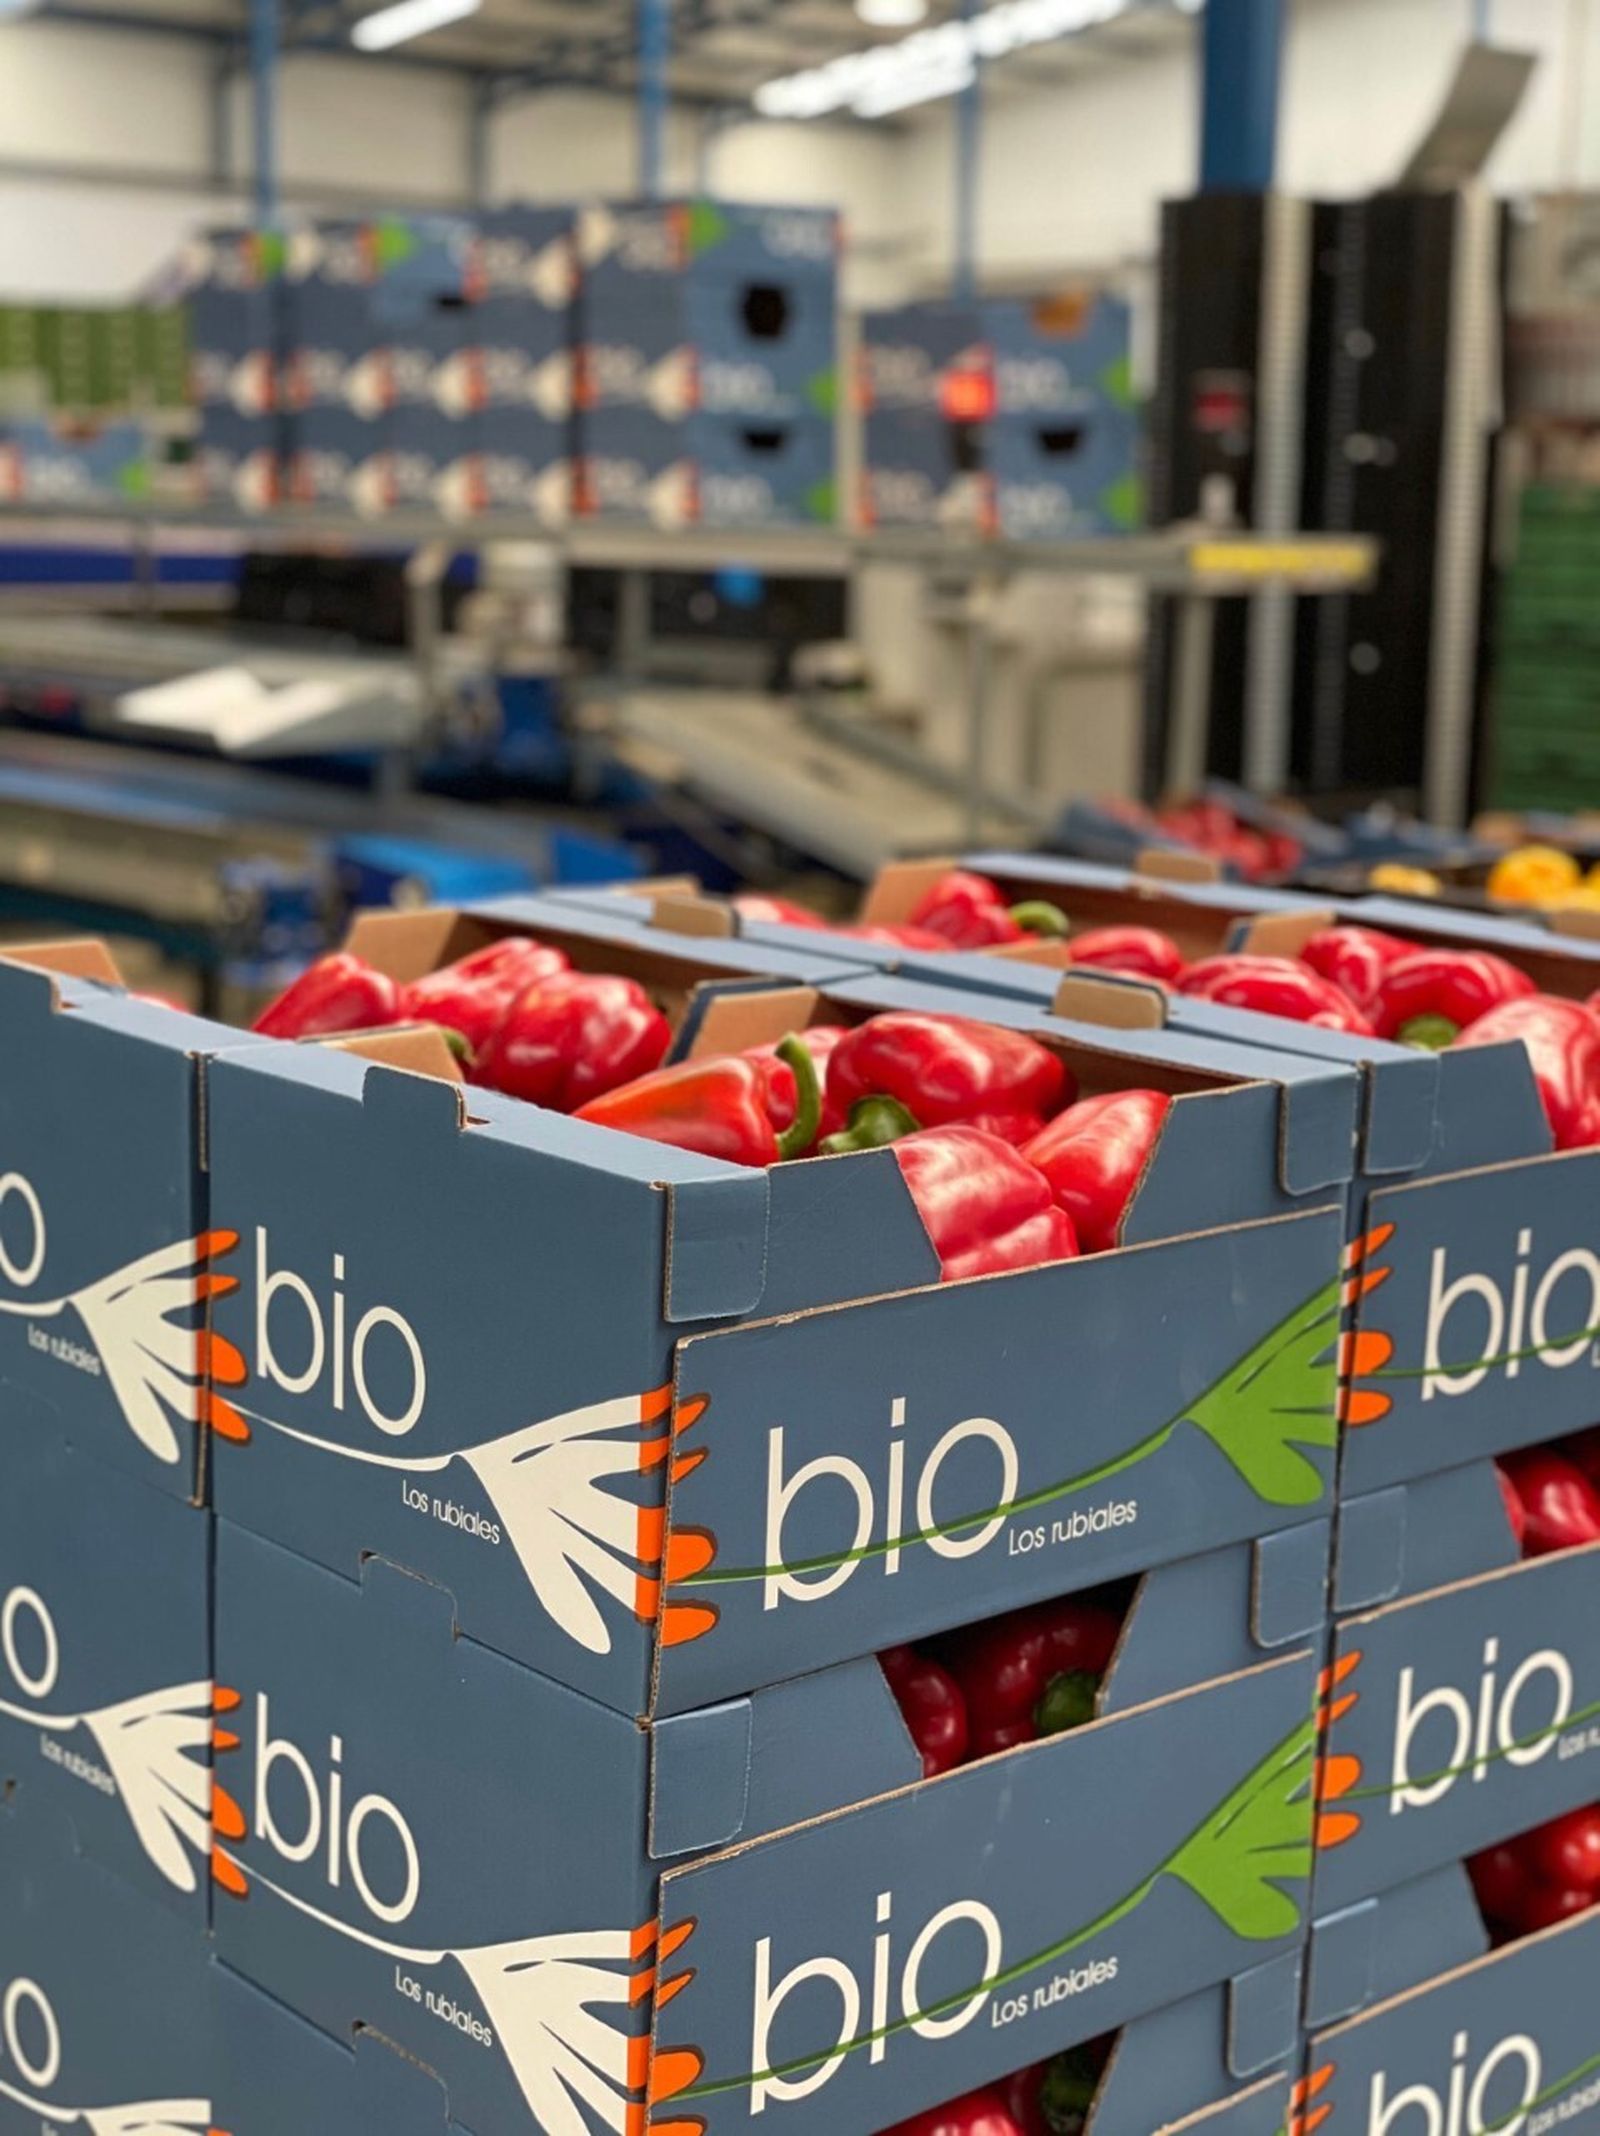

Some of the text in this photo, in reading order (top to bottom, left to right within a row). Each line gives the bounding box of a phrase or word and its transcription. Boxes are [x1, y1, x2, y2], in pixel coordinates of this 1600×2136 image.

[256, 1225, 426, 1436] bio
[1421, 1228, 1600, 1402] bio
[402, 1479, 500, 1545] Los rubiales
[763, 1396, 1020, 1612] bio
[1008, 1500, 1138, 1556] Los rubiales
[255, 1691, 420, 1924] bio
[1389, 1636, 1574, 1816] bio
[395, 1965, 493, 2047] Los rubiales
[749, 1891, 1003, 2116] bio
[991, 1956, 1119, 2029] Los rubiales
